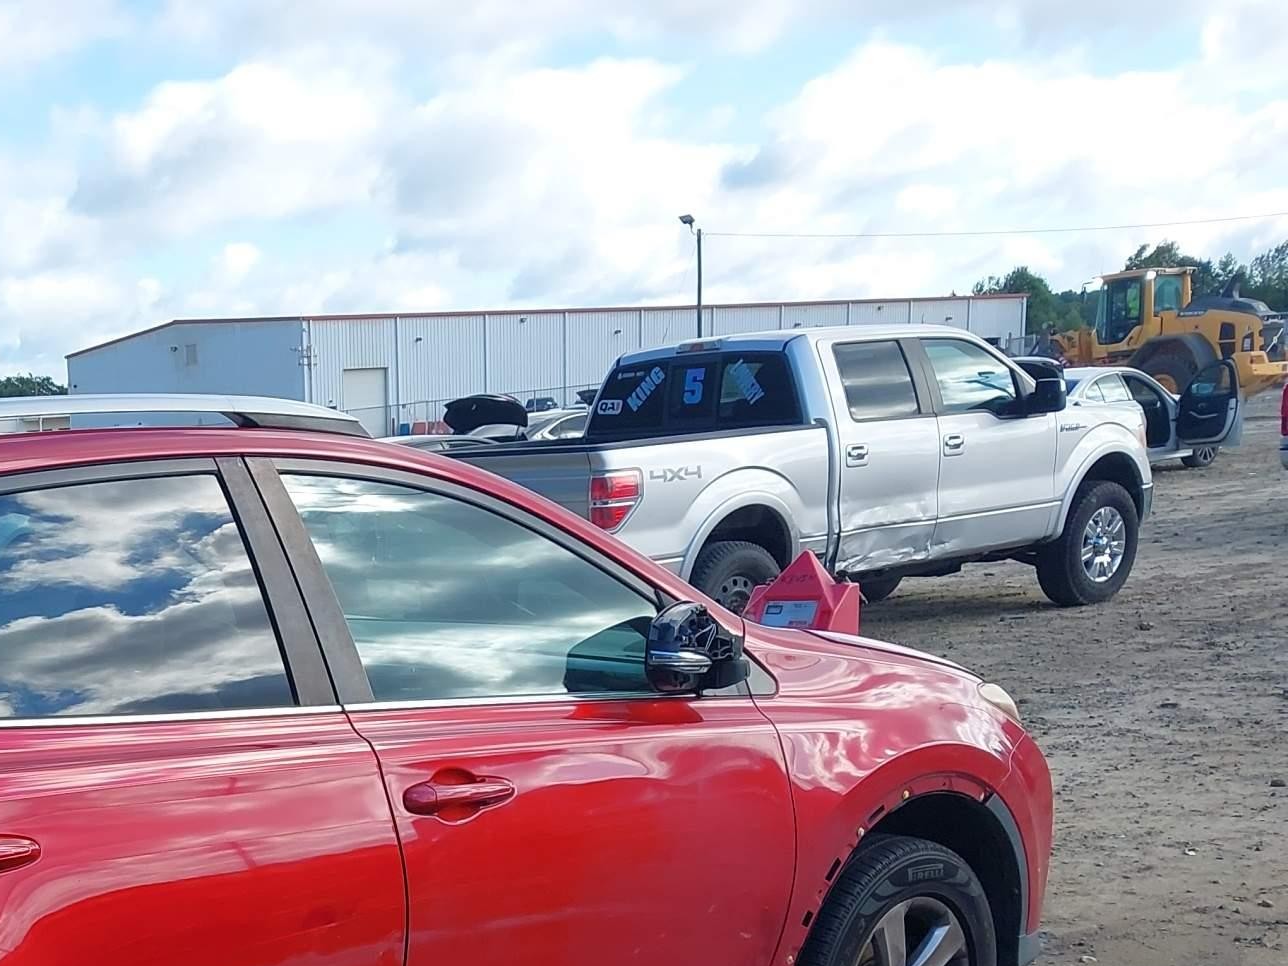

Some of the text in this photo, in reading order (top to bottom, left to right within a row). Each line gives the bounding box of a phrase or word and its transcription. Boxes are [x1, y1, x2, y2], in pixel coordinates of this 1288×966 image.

[626, 366, 665, 412] KING
[683, 367, 706, 405] 5
[907, 863, 944, 882] PIRELLI
